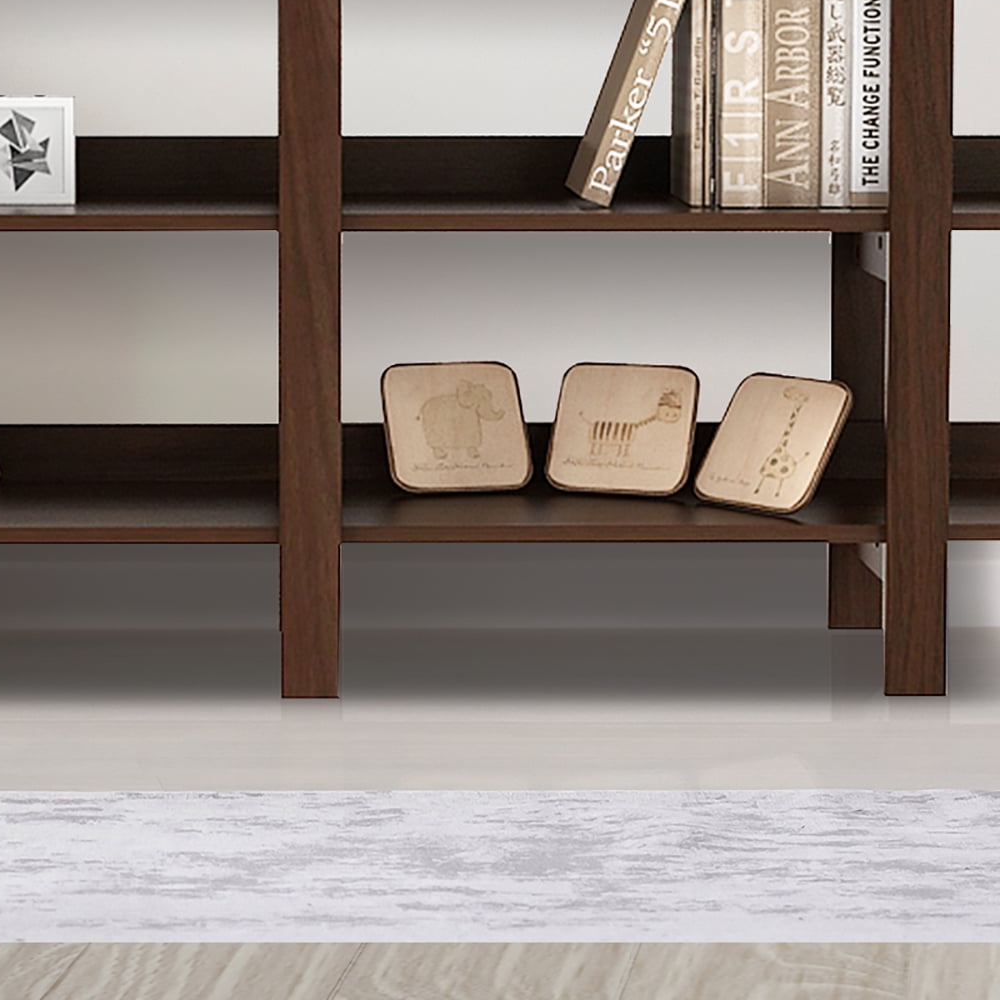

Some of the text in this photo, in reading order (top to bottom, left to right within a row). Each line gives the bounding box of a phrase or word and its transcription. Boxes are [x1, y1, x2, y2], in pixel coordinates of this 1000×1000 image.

[588, 67, 654, 195] Parker
[764, 7, 810, 190] ANN ARBOR
[862, 83, 881, 150] CHANGE
[861, 155, 881, 187] THE
